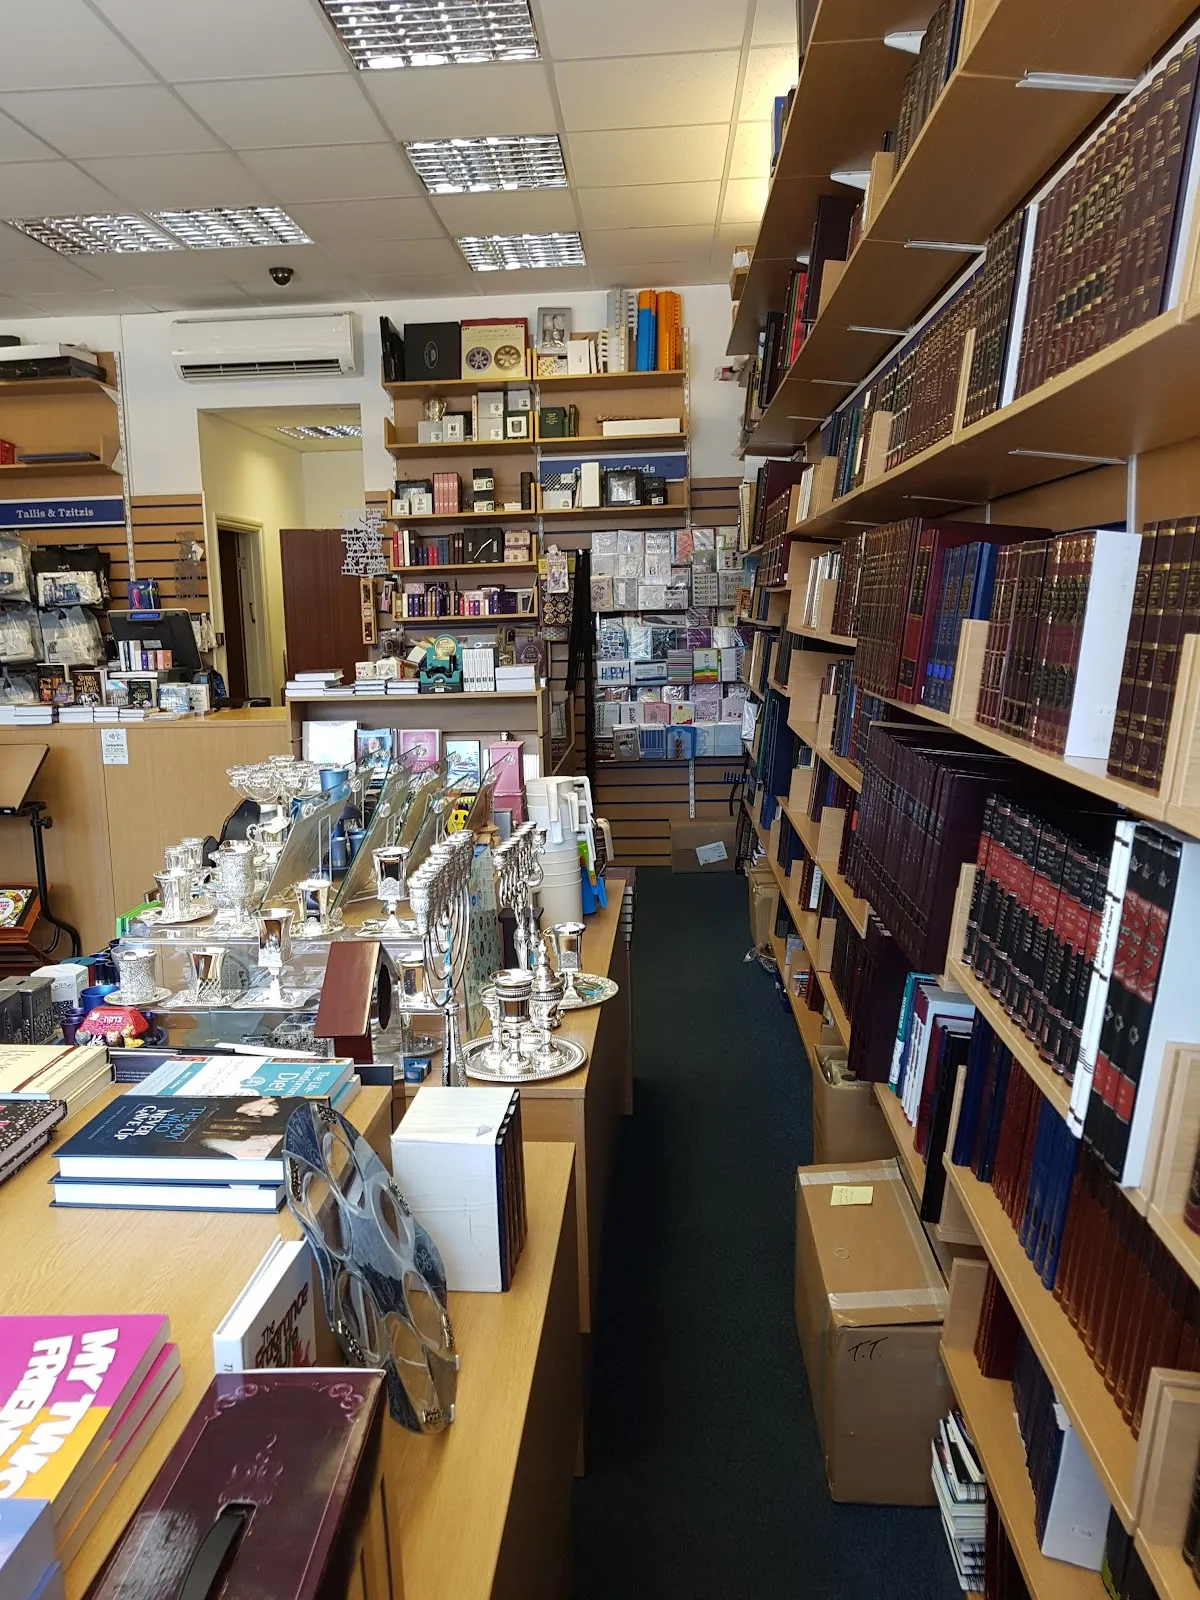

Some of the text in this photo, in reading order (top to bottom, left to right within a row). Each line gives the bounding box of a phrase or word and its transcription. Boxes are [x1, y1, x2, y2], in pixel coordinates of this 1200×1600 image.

[16, 507, 94, 518] Tallis & Tzitzis
[601, 666, 625, 680] HAPPY
[264, 1072, 297, 1093] Diet
[285, 1065, 321, 1096] Transformin
[317, 1070, 331, 1082] The
[125, 1105, 157, 1126] GAVE
[134, 1108, 175, 1136] NEVER
[155, 1113, 185, 1133] WHO
[165, 1106, 206, 1140] THE BOY
[114, 1128, 136, 1140] UP
[261, 1320, 276, 1340] The
[66, 1327, 119, 1392] MY
